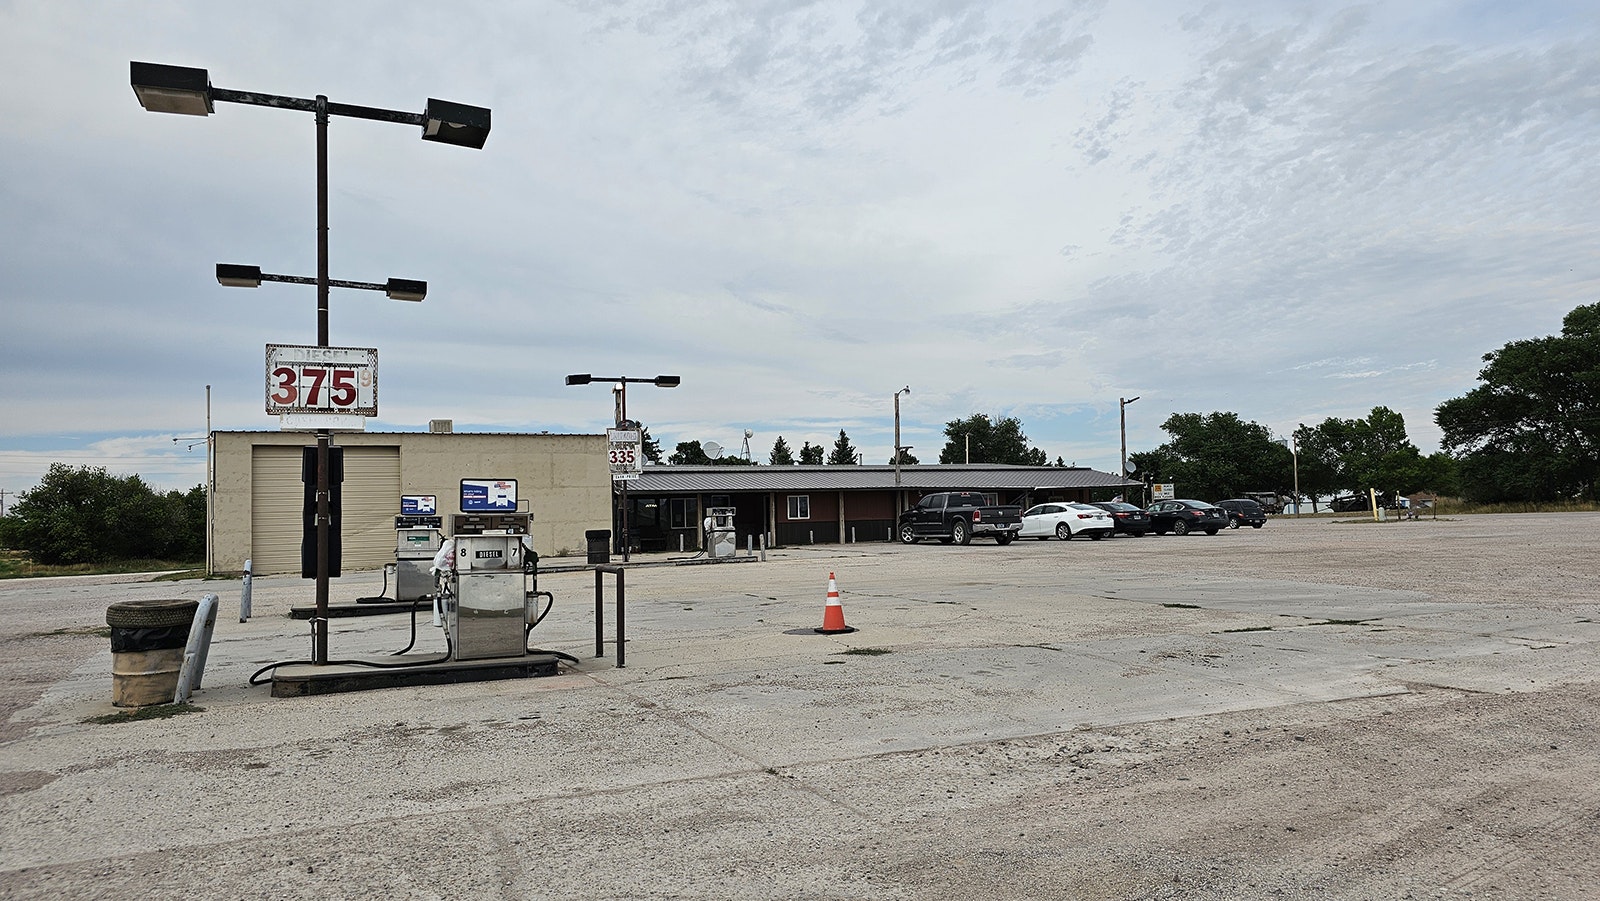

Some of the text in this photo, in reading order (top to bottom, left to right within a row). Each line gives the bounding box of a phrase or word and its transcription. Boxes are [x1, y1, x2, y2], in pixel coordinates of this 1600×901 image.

[360, 369, 372, 387] 9
[609, 450, 635, 464] 335
[460, 547, 467, 557] 8
[511, 547, 518, 557] 7
